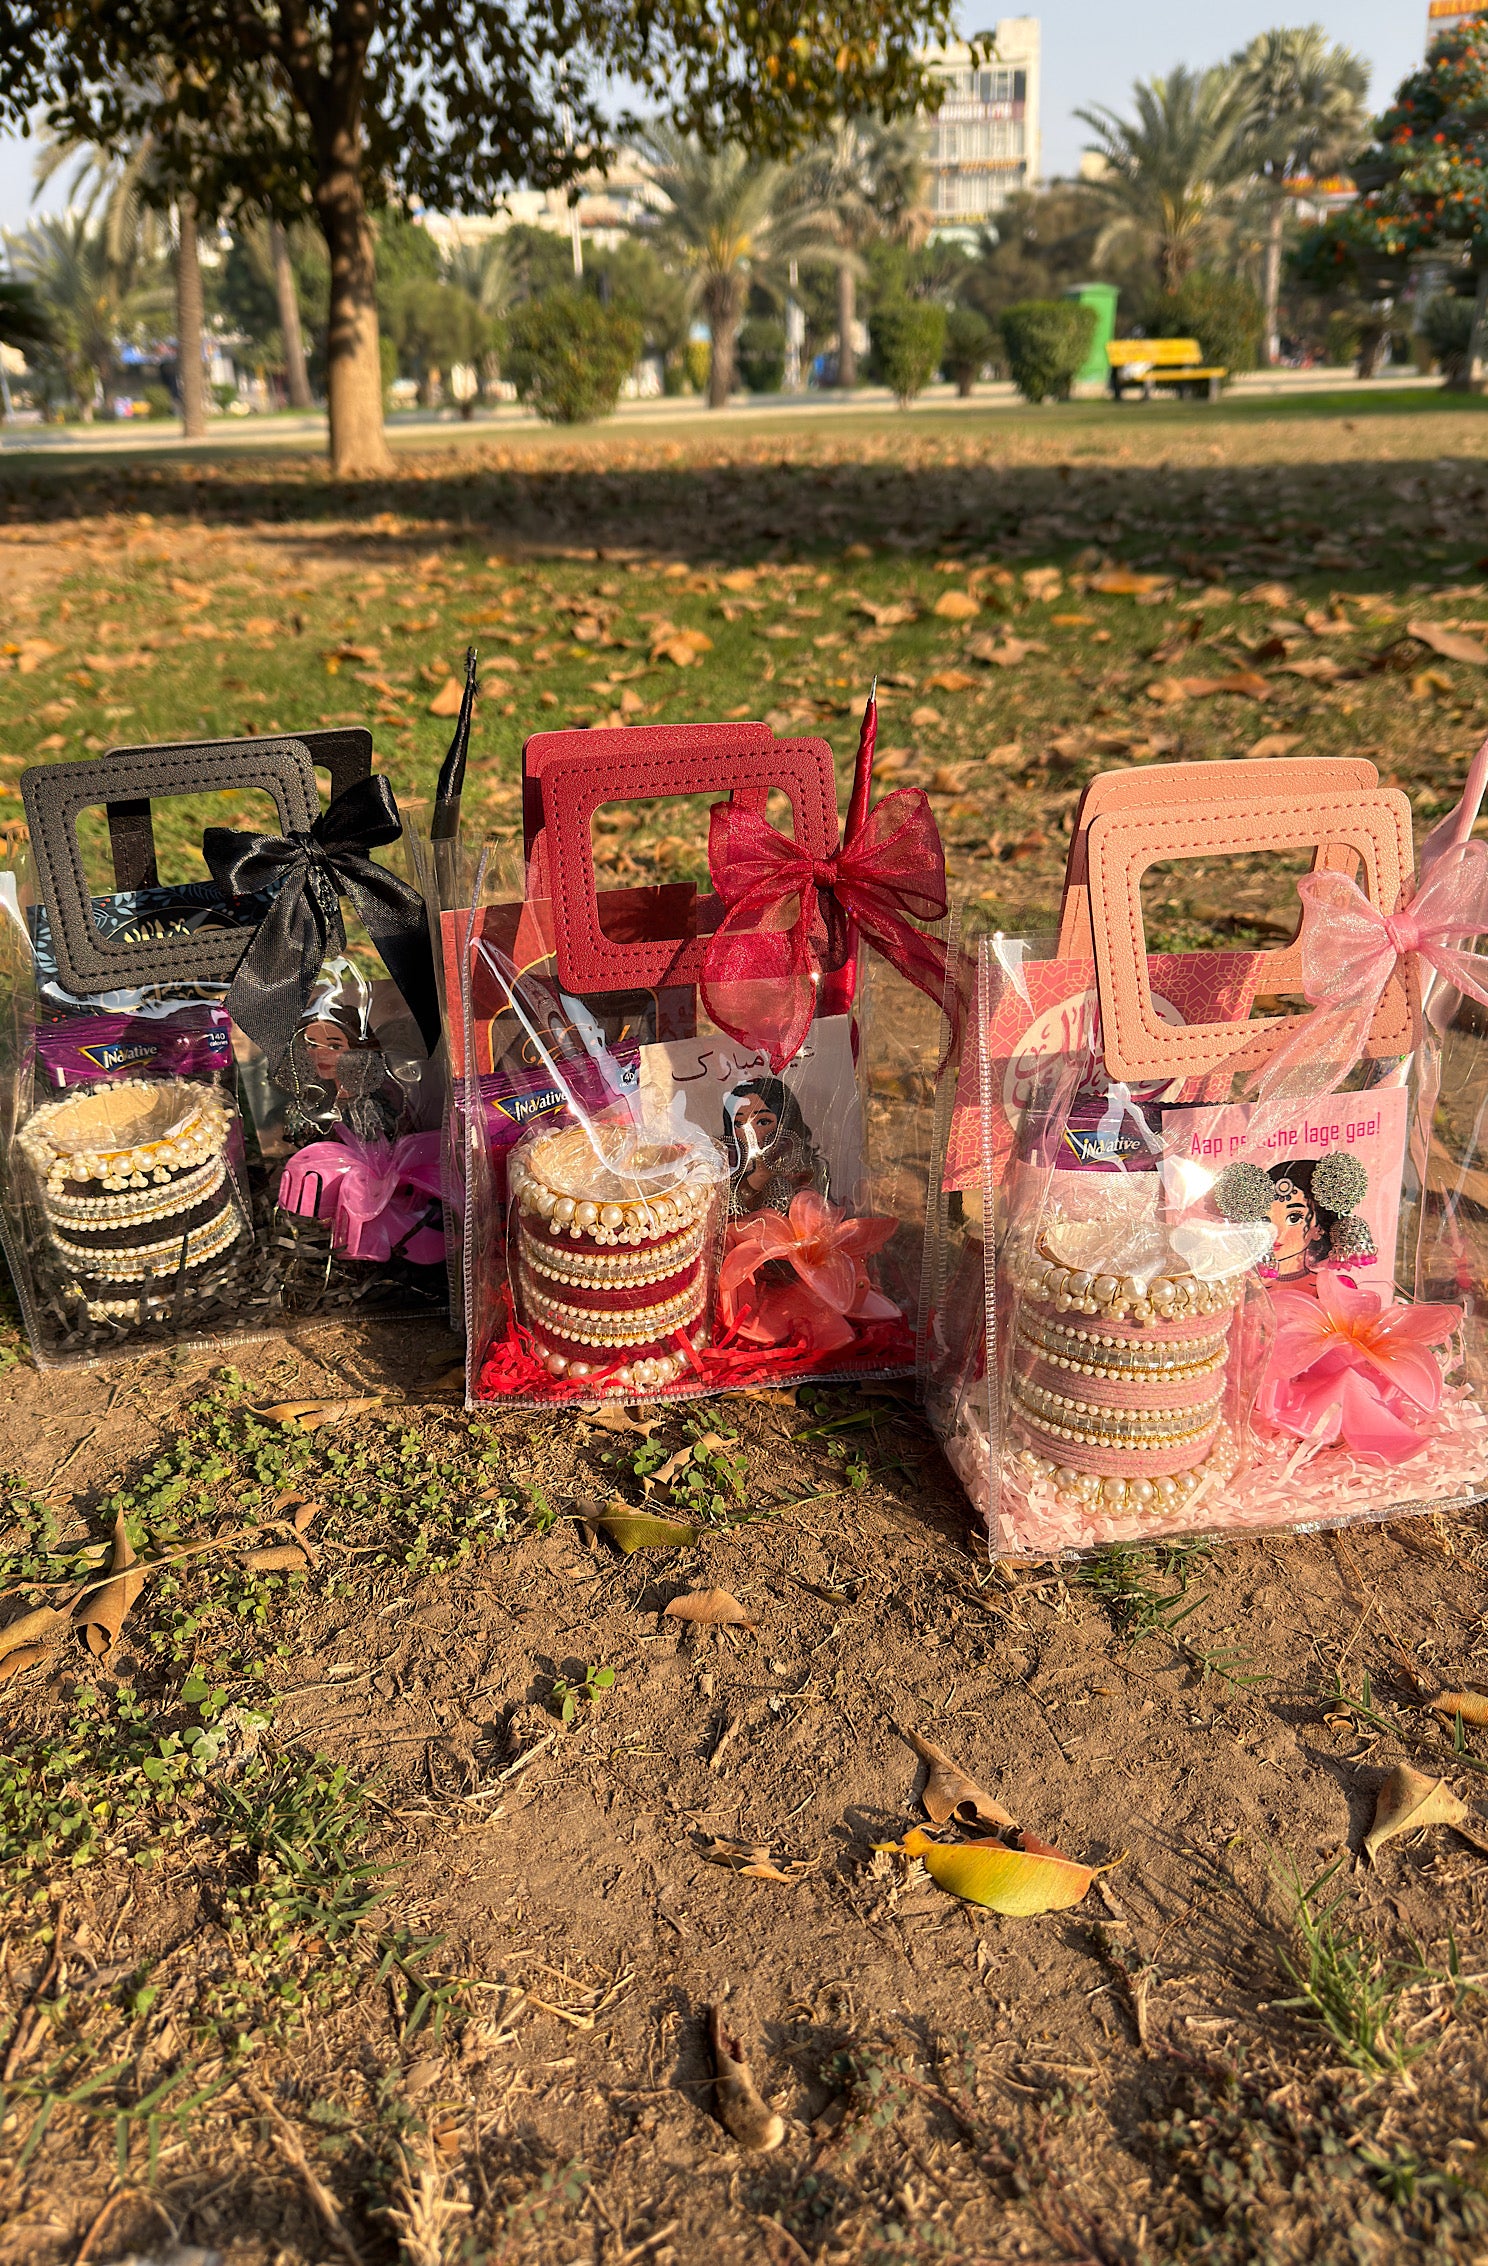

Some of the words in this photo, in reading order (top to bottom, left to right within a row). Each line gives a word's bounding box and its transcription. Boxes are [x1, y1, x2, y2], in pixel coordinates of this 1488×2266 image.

[1190, 1132, 1222, 1158] Aap
[1256, 1130, 1298, 1148] che
[1304, 1120, 1340, 1147] lage
[1346, 1111, 1381, 1144] gae!
